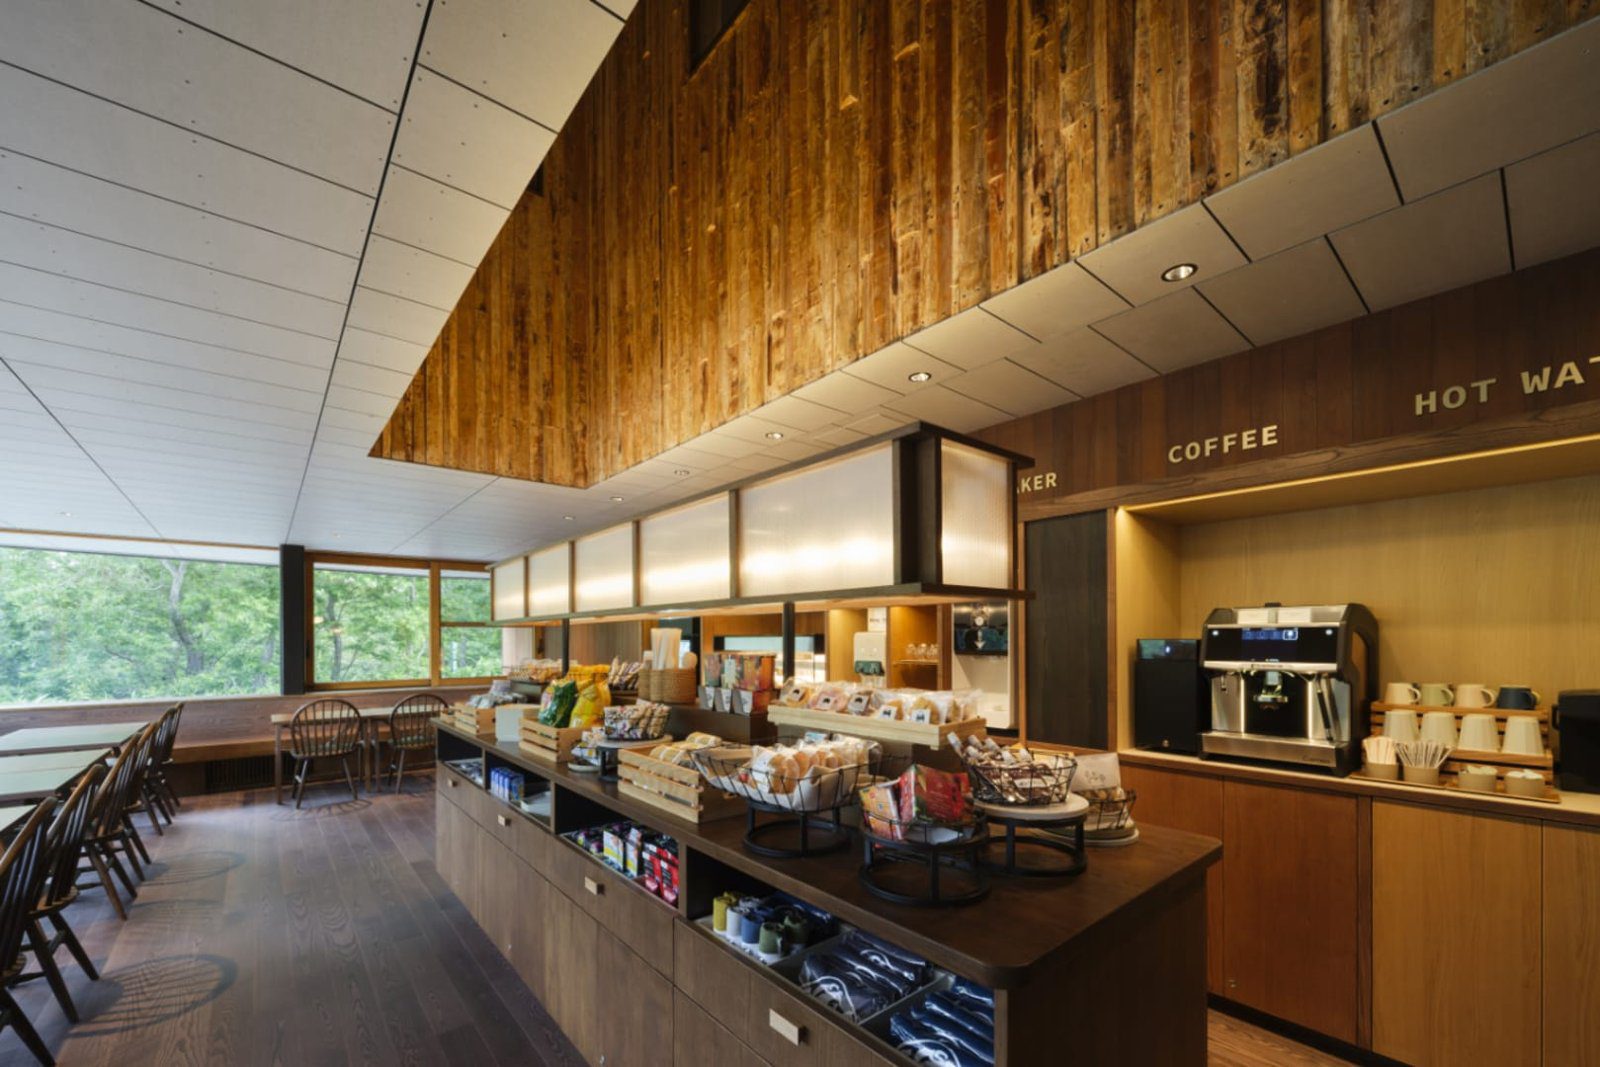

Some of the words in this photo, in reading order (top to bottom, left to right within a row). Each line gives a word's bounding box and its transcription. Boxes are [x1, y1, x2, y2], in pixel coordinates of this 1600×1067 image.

[1415, 378, 1497, 416] HOT
[1168, 425, 1278, 463] COFFEE
[1016, 472, 1057, 494] KER
